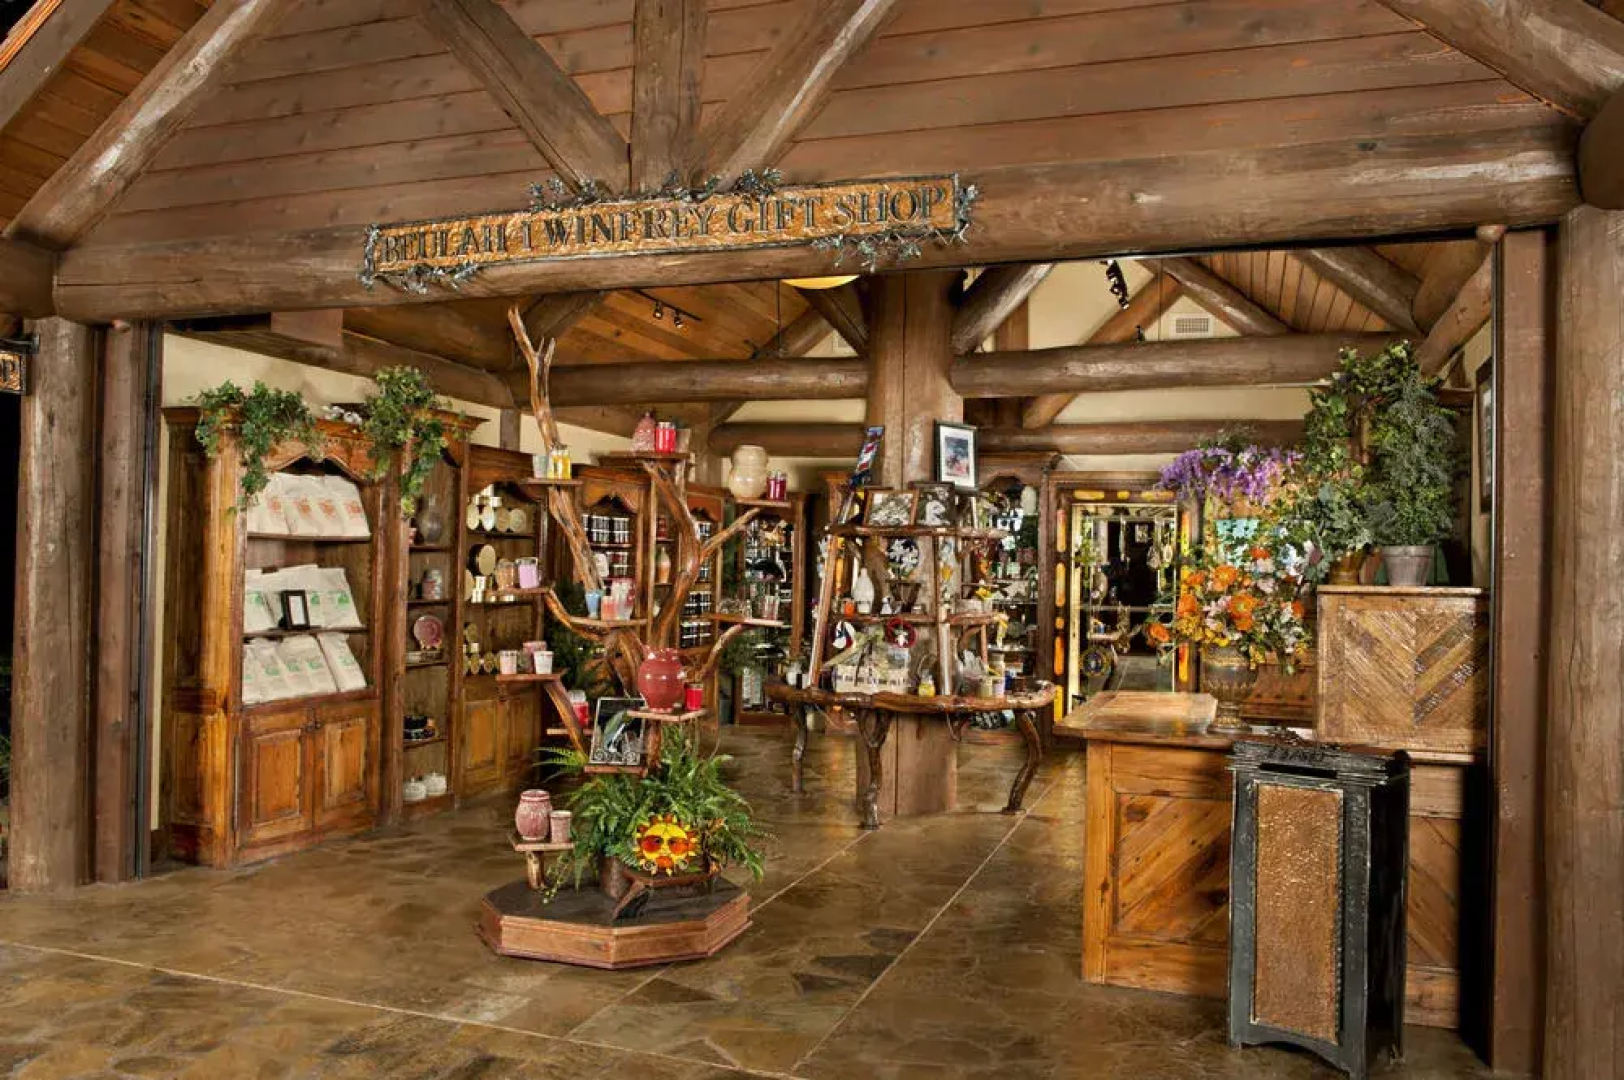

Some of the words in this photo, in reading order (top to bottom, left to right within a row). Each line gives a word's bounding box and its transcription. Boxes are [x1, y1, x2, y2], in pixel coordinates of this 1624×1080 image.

[380, 223, 507, 264] BEULAH
[544, 204, 718, 246] WINFREY
[727, 196, 822, 235] GIFT
[834, 185, 946, 230] SHOP
